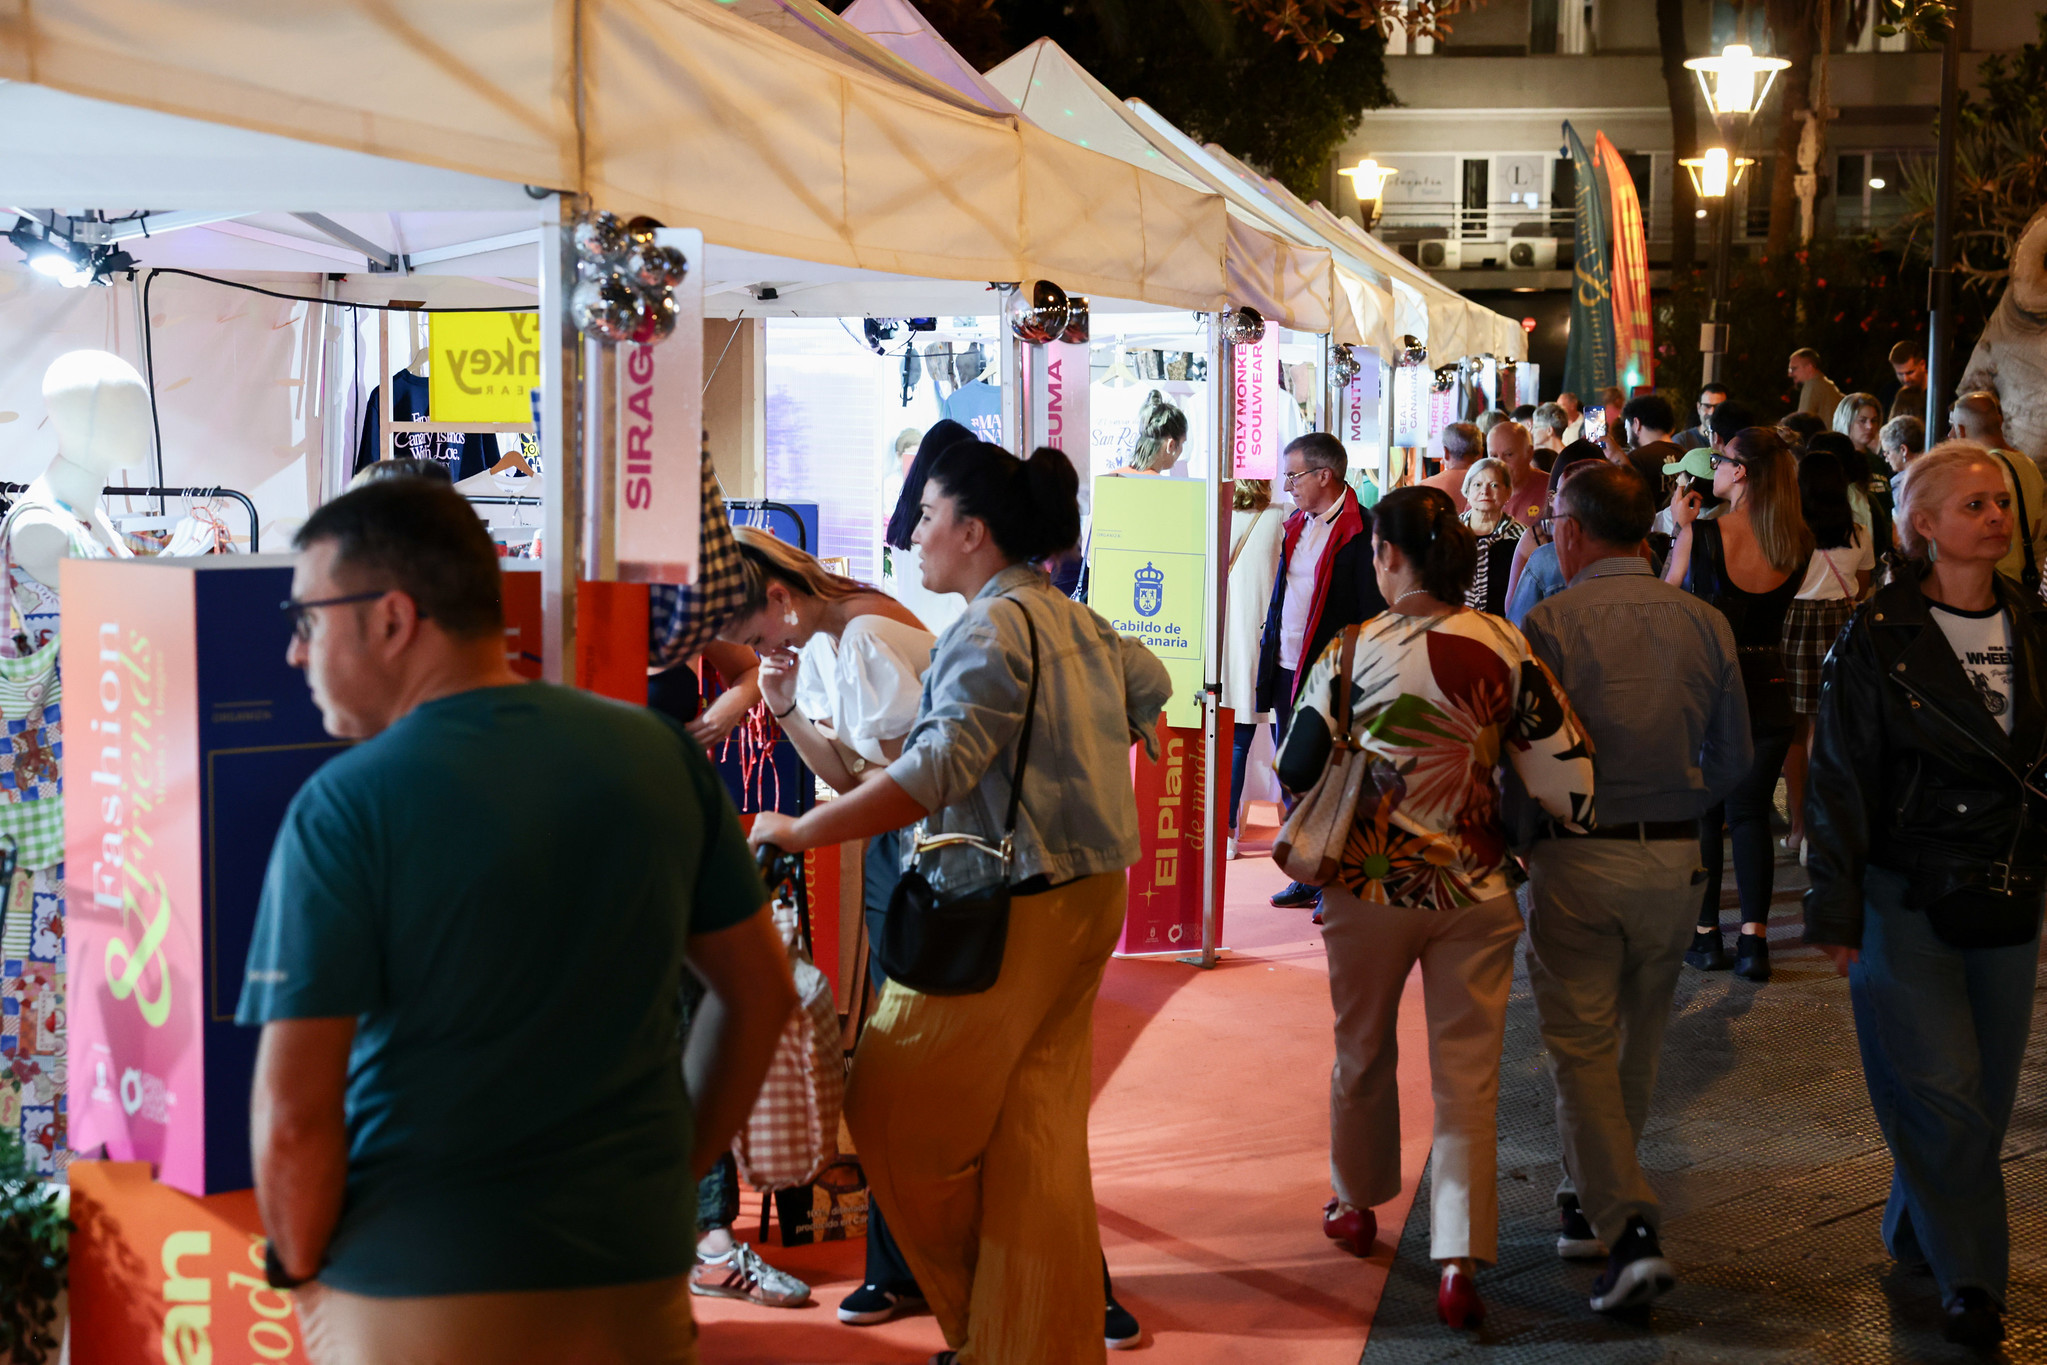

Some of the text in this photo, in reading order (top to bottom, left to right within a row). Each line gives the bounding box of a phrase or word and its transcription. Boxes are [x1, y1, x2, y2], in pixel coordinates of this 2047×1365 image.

[625, 338, 655, 511] SIRAG
[1047, 358, 1063, 452] EUMA
[1236, 343, 1248, 469] HOLY MONKE
[1251, 344, 1263, 456] SOULWEAR
[1399, 411, 1408, 435] SEA
[1410, 363, 1418, 429] CANARIAS
[1430, 393, 1440, 436] THREE
[1441, 389, 1451, 430] ONES
[1111, 619, 1181, 635] Cabildo de
[1138, 634, 1188, 648] Canaria
[91, 621, 125, 910] Fashion
[119, 630, 155, 896] Friends
[1155, 738, 1184, 887] El Plan
[1184, 820, 1205, 850] de
[161, 1231, 213, 1365] an
